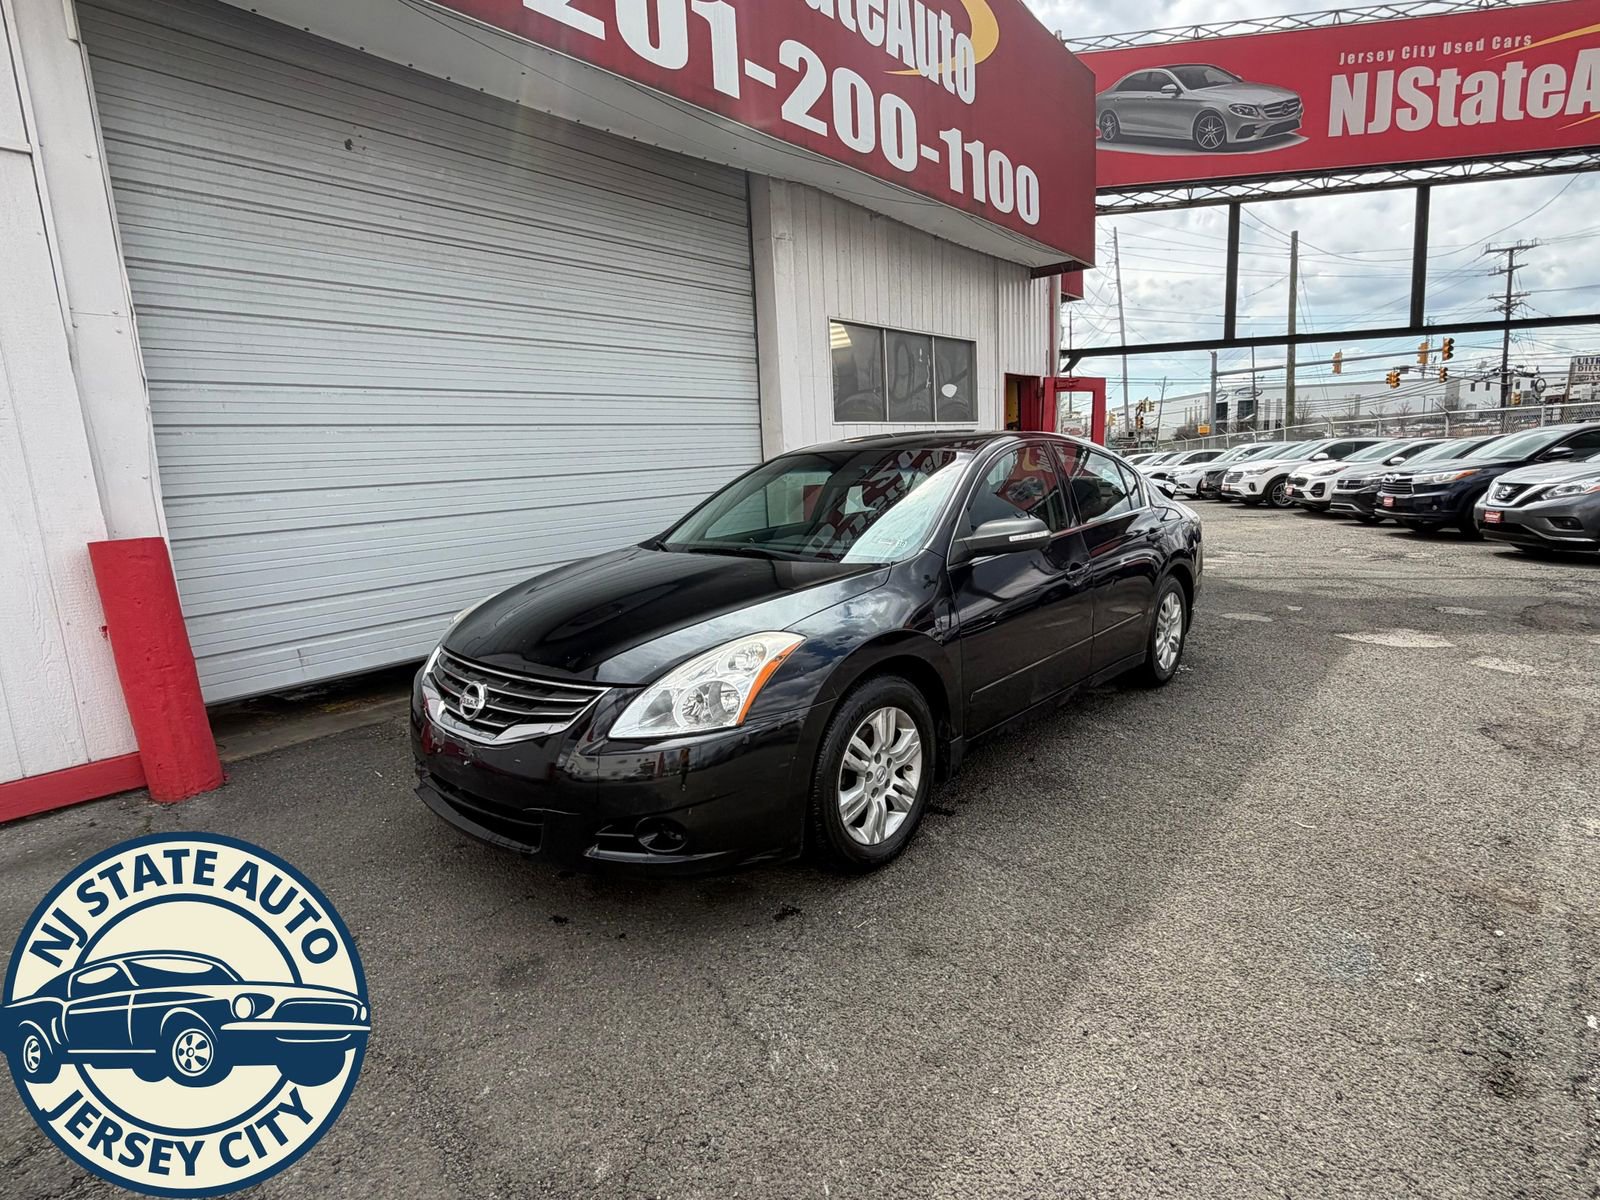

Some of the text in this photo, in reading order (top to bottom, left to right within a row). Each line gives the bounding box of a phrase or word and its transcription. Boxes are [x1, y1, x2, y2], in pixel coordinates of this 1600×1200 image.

[1339, 34, 1533, 66] Jersey City Used Cars
